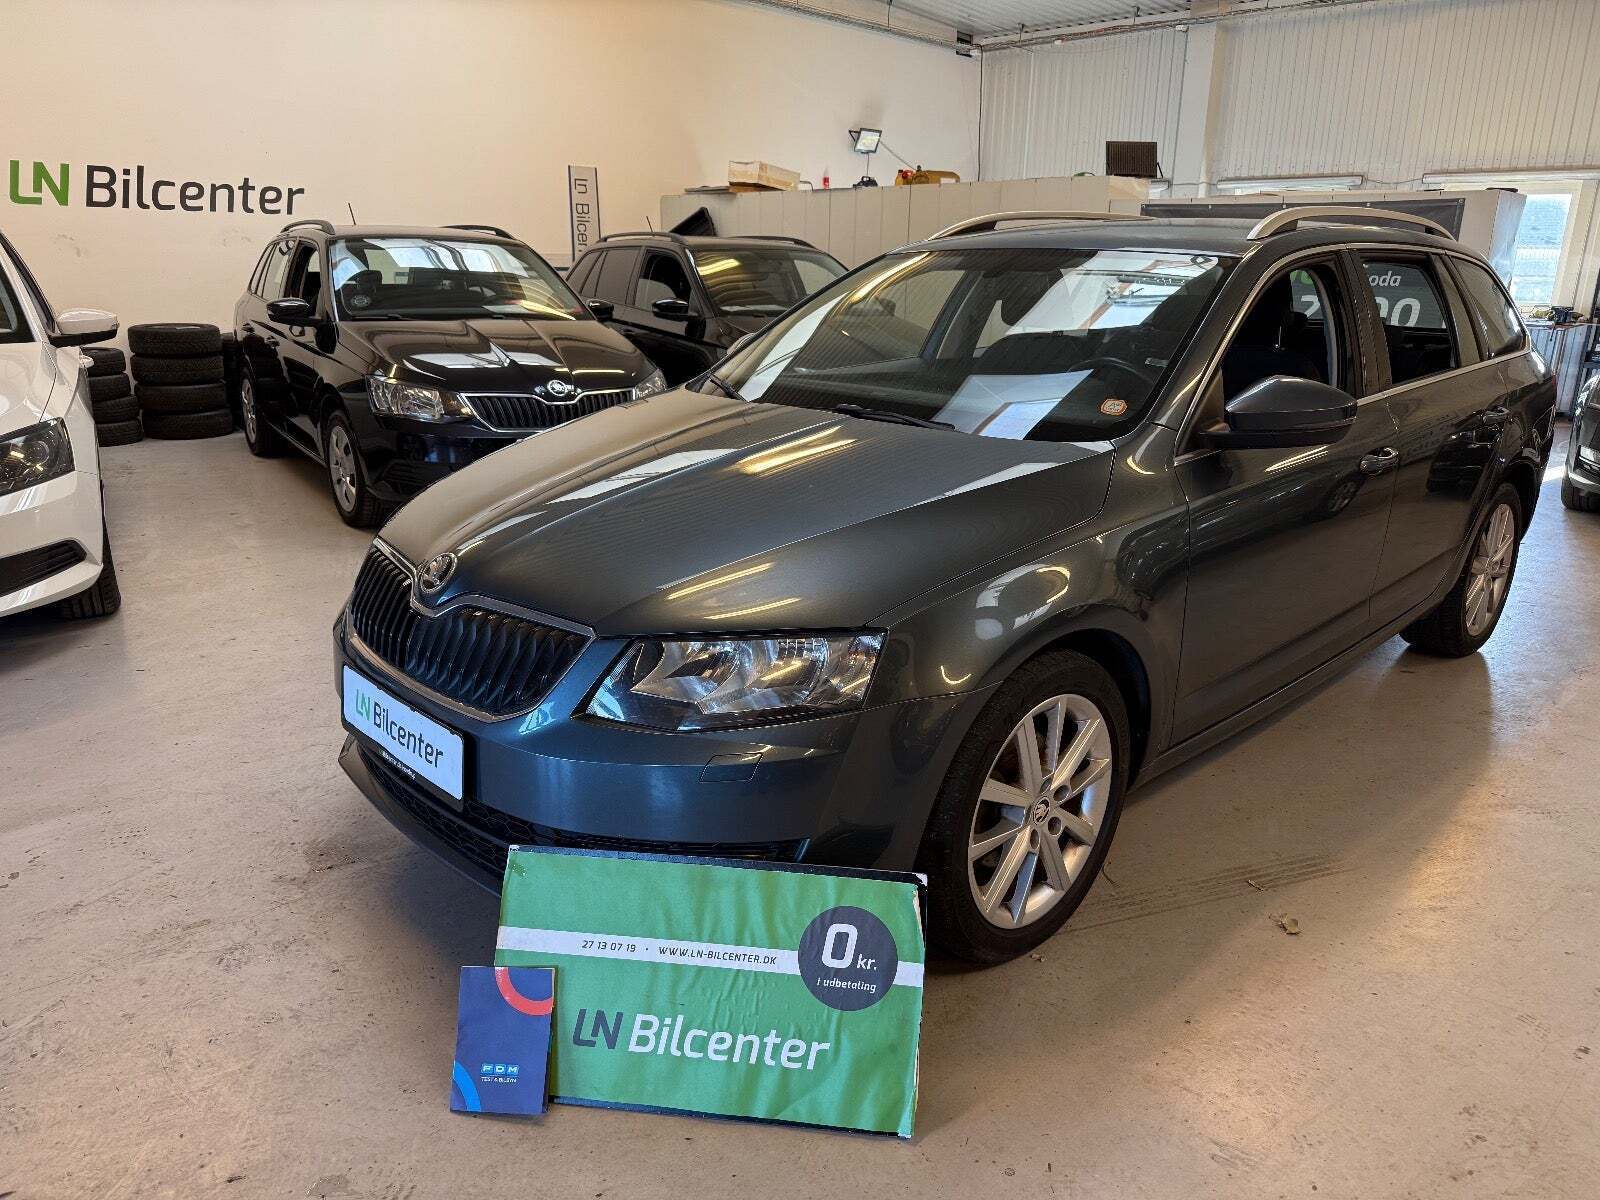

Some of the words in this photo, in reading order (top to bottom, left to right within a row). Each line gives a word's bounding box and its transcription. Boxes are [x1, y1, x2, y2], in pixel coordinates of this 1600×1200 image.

[9, 159, 69, 206] LN
[85, 164, 305, 215] Bilcenter
[355, 688, 371, 721] LN
[373, 701, 444, 768] Bilcenter
[582, 940, 594, 949] 27
[598, 941, 607, 950] 13
[610, 942, 623, 951] 07
[626, 943, 636, 953] 19
[658, 946, 777, 965] WWW.LN-BILCENTER.DK
[821, 923, 858, 968] 0
[856, 953, 878, 970] kr.
[823, 977, 877, 994] udbetaling
[572, 1008, 624, 1050] LN
[628, 1013, 830, 1070] Bilcenter
[482, 1064, 518, 1074] FDM
